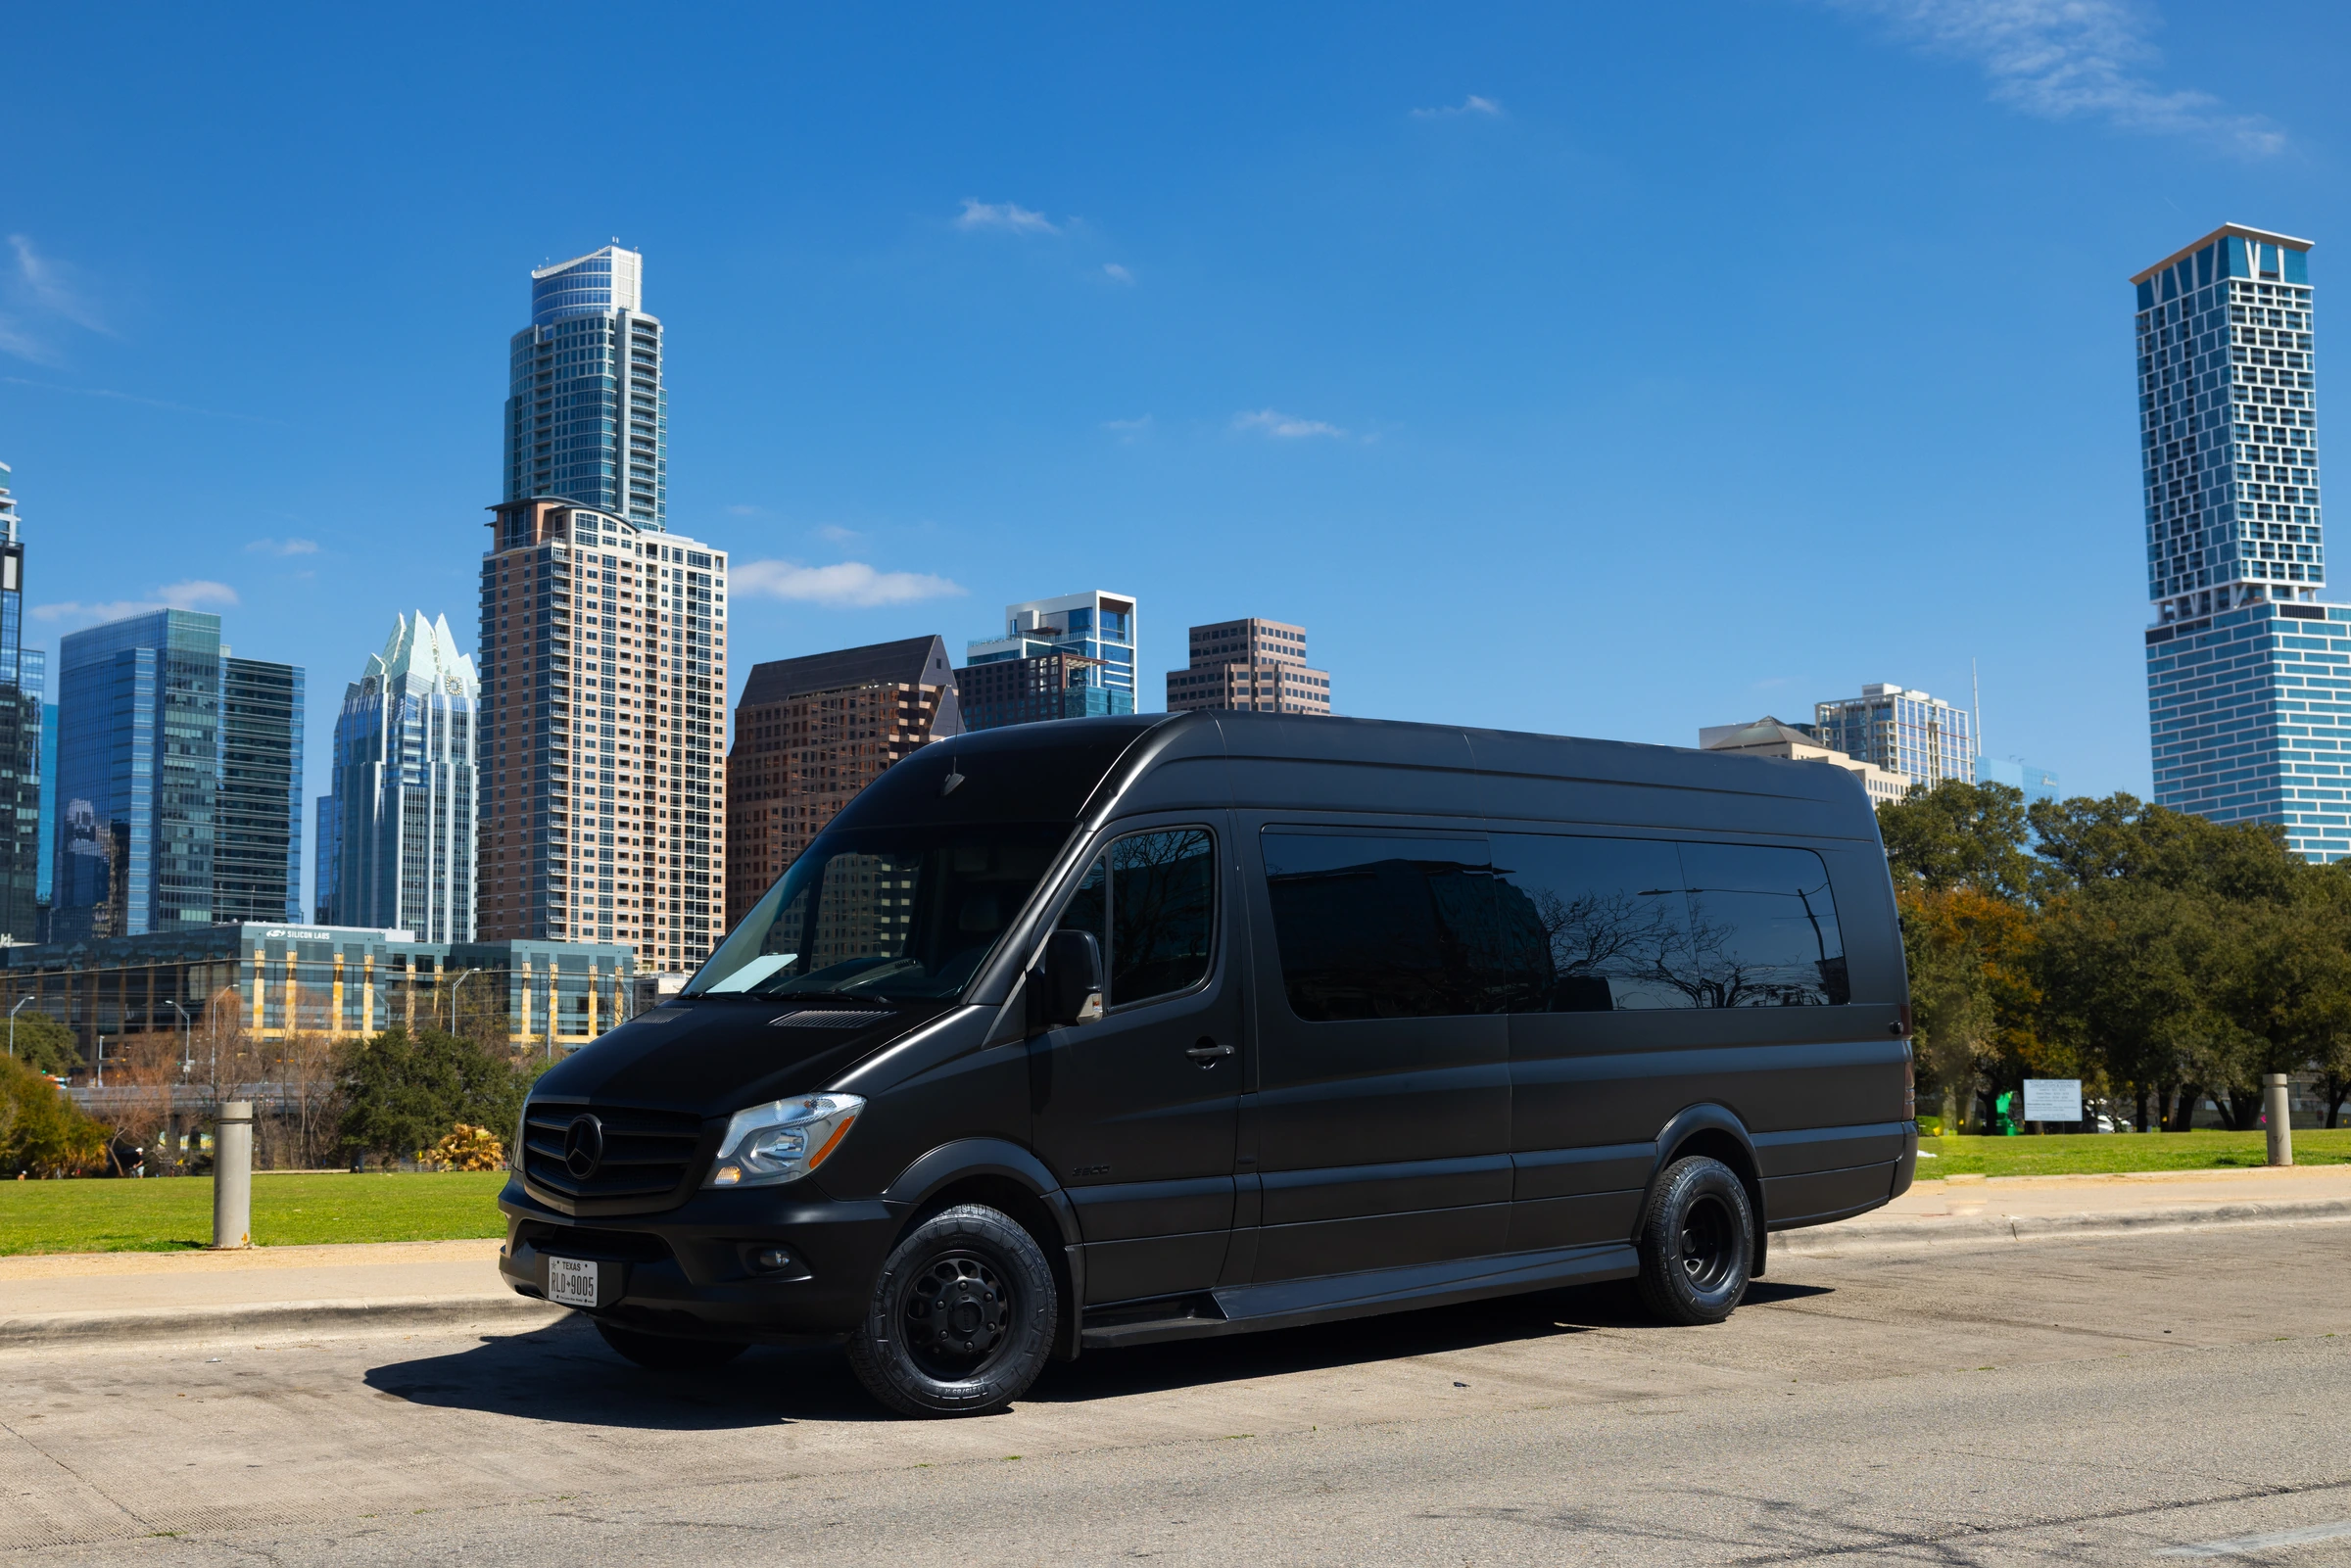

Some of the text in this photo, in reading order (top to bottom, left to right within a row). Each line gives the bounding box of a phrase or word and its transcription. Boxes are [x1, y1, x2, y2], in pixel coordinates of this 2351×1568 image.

[287, 930, 330, 940] SILICON LABS
[562, 1260, 582, 1272] TEXAS
